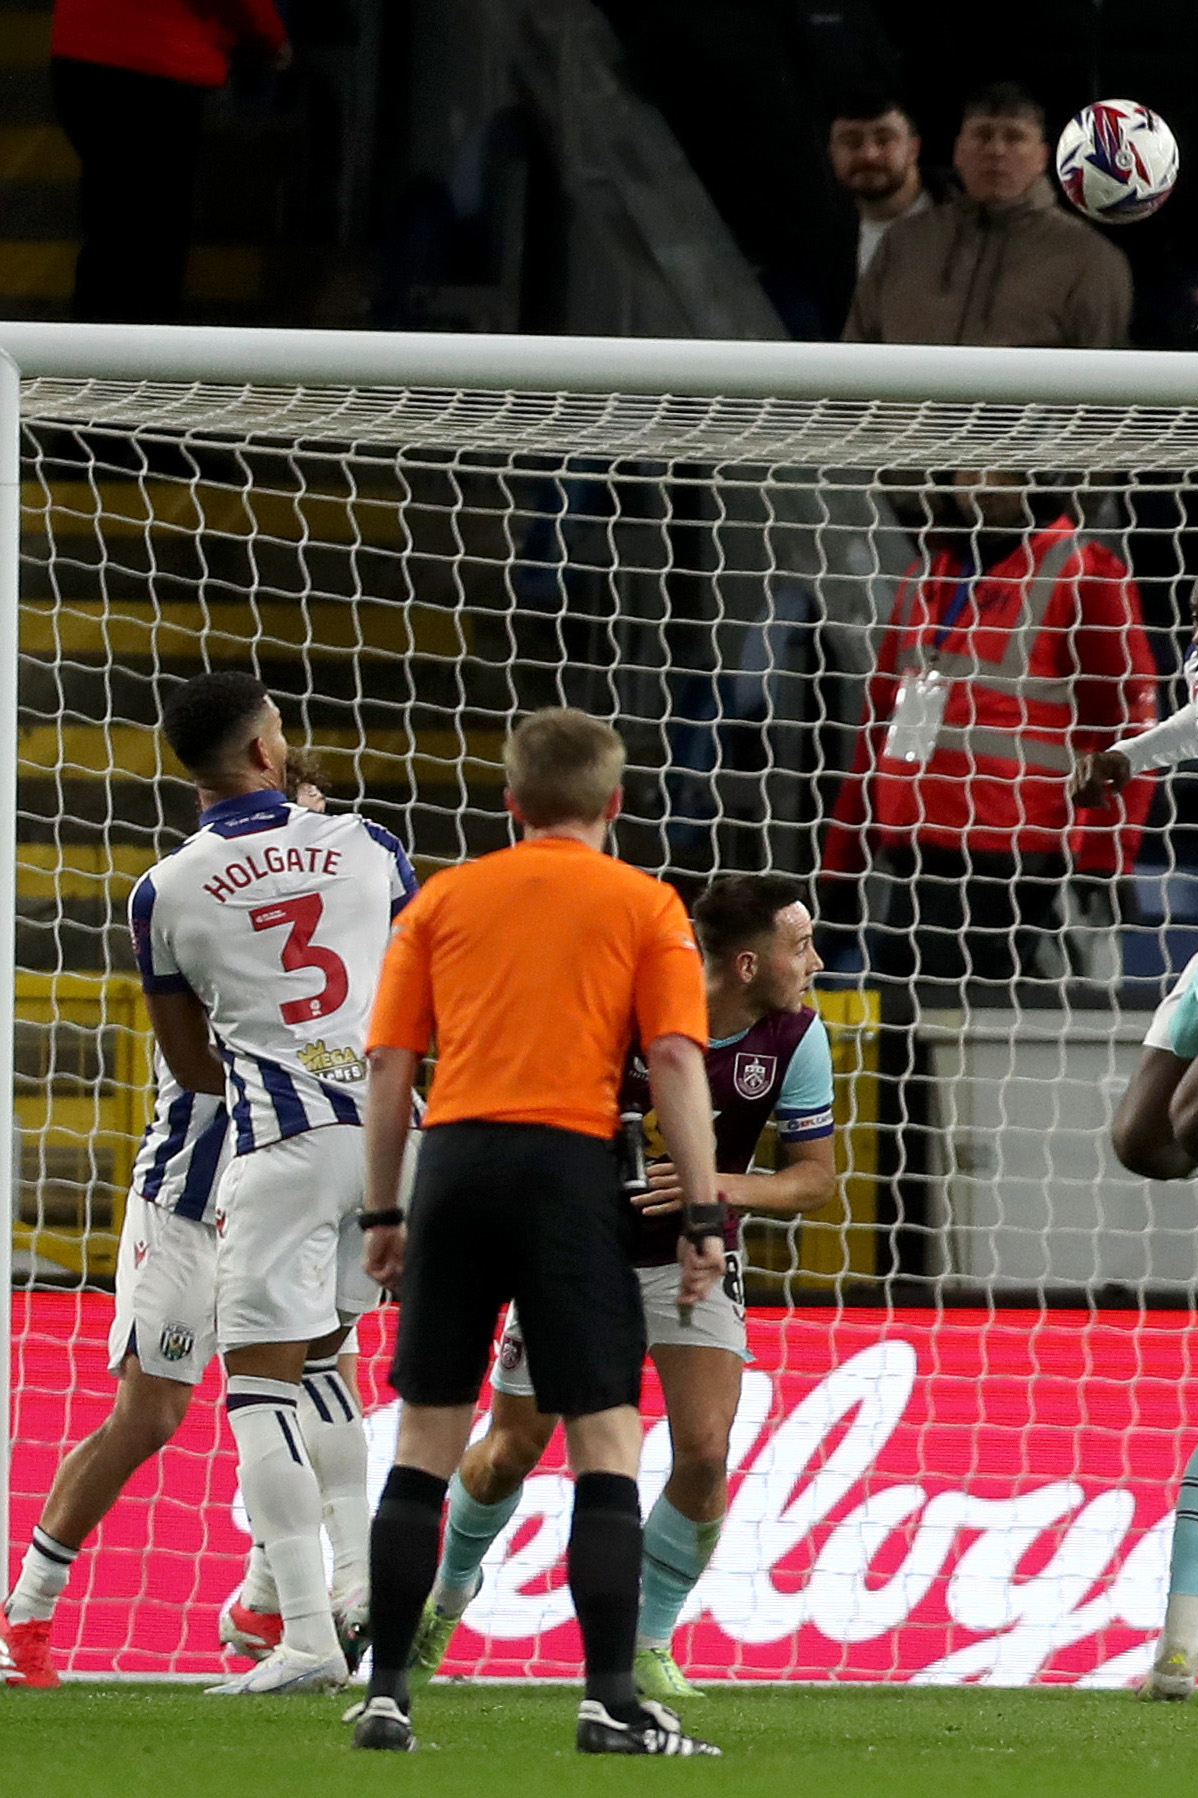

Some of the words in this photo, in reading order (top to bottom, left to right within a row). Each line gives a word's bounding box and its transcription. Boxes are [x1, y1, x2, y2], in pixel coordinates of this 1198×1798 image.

[203, 846, 342, 903] HOLGATE
[249, 892, 348, 1025] 3
[303, 1047, 357, 1072] MEGA
